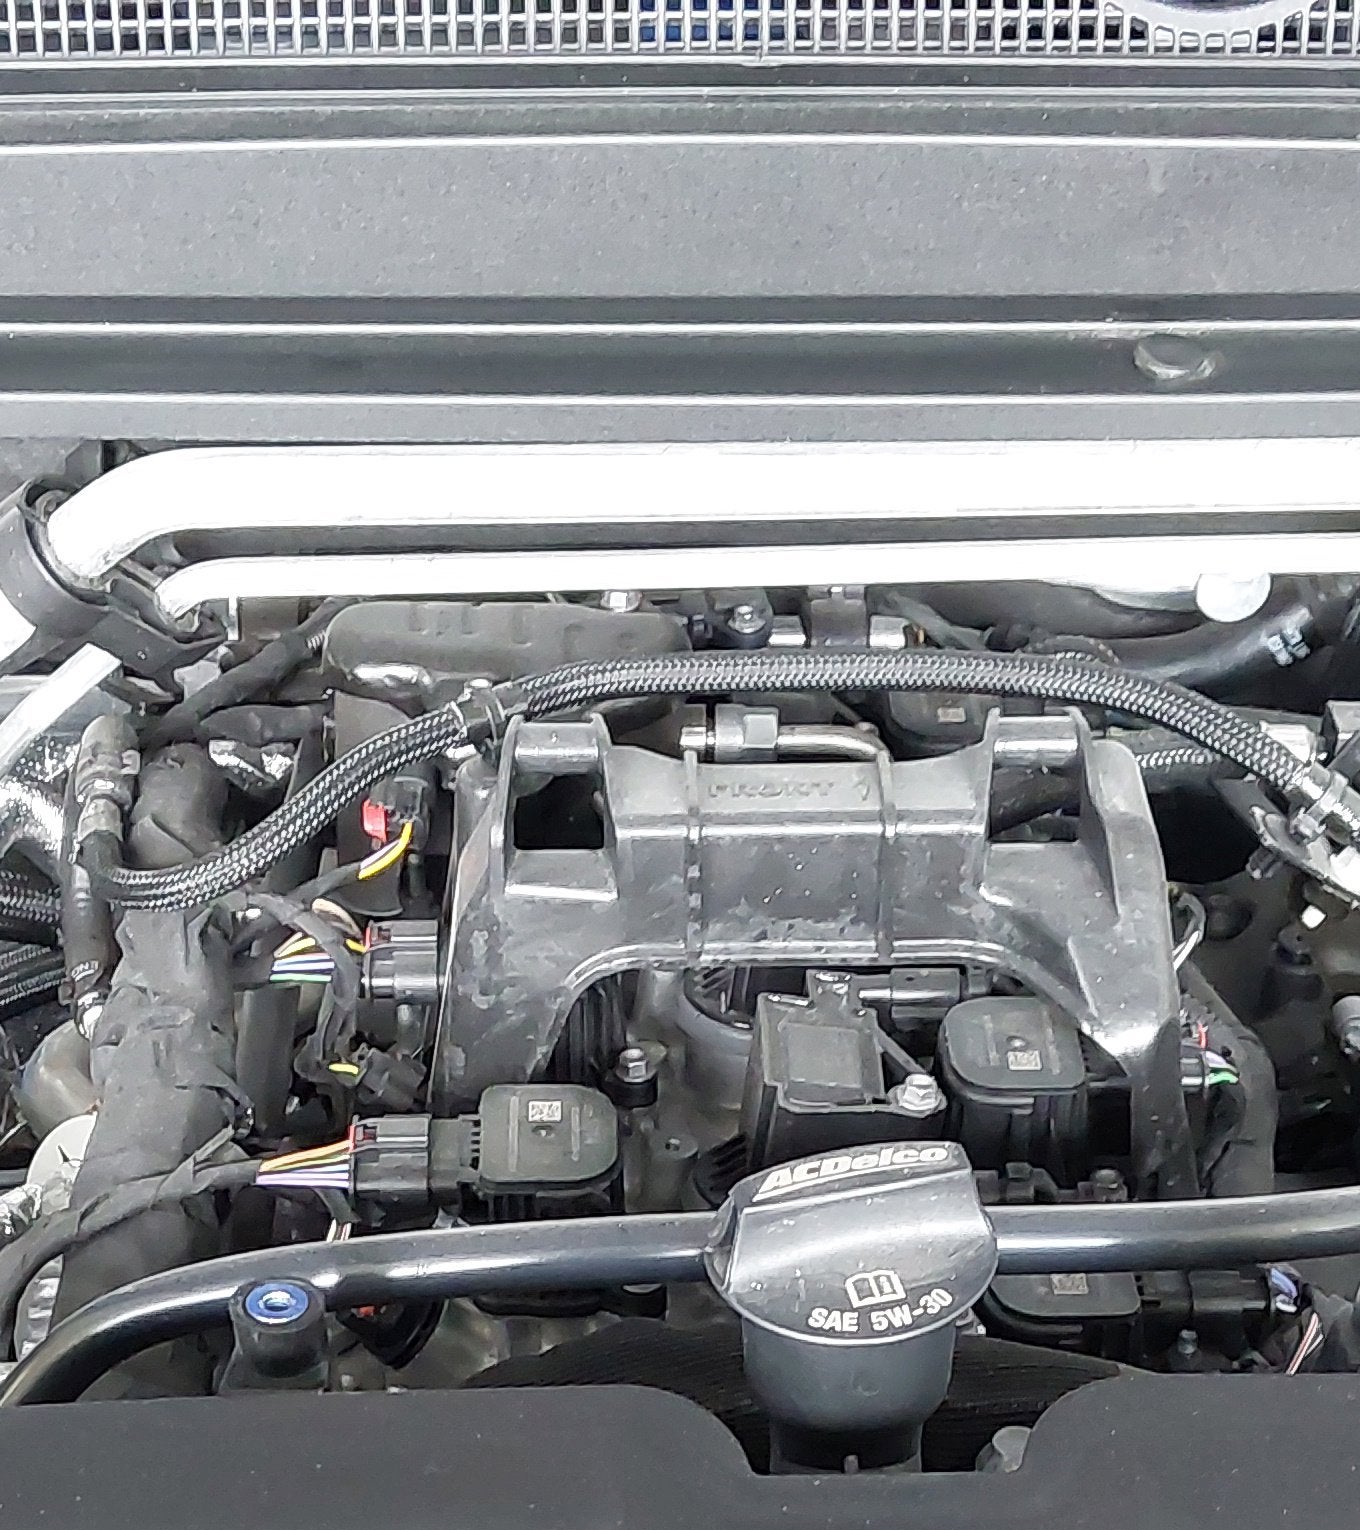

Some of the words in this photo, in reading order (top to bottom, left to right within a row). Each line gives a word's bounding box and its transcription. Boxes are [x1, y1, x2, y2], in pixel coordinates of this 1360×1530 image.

[757, 1146, 949, 1194] ACDelco
[808, 1307, 859, 1332] SAE
[870, 1288, 953, 1331] 5W-30
